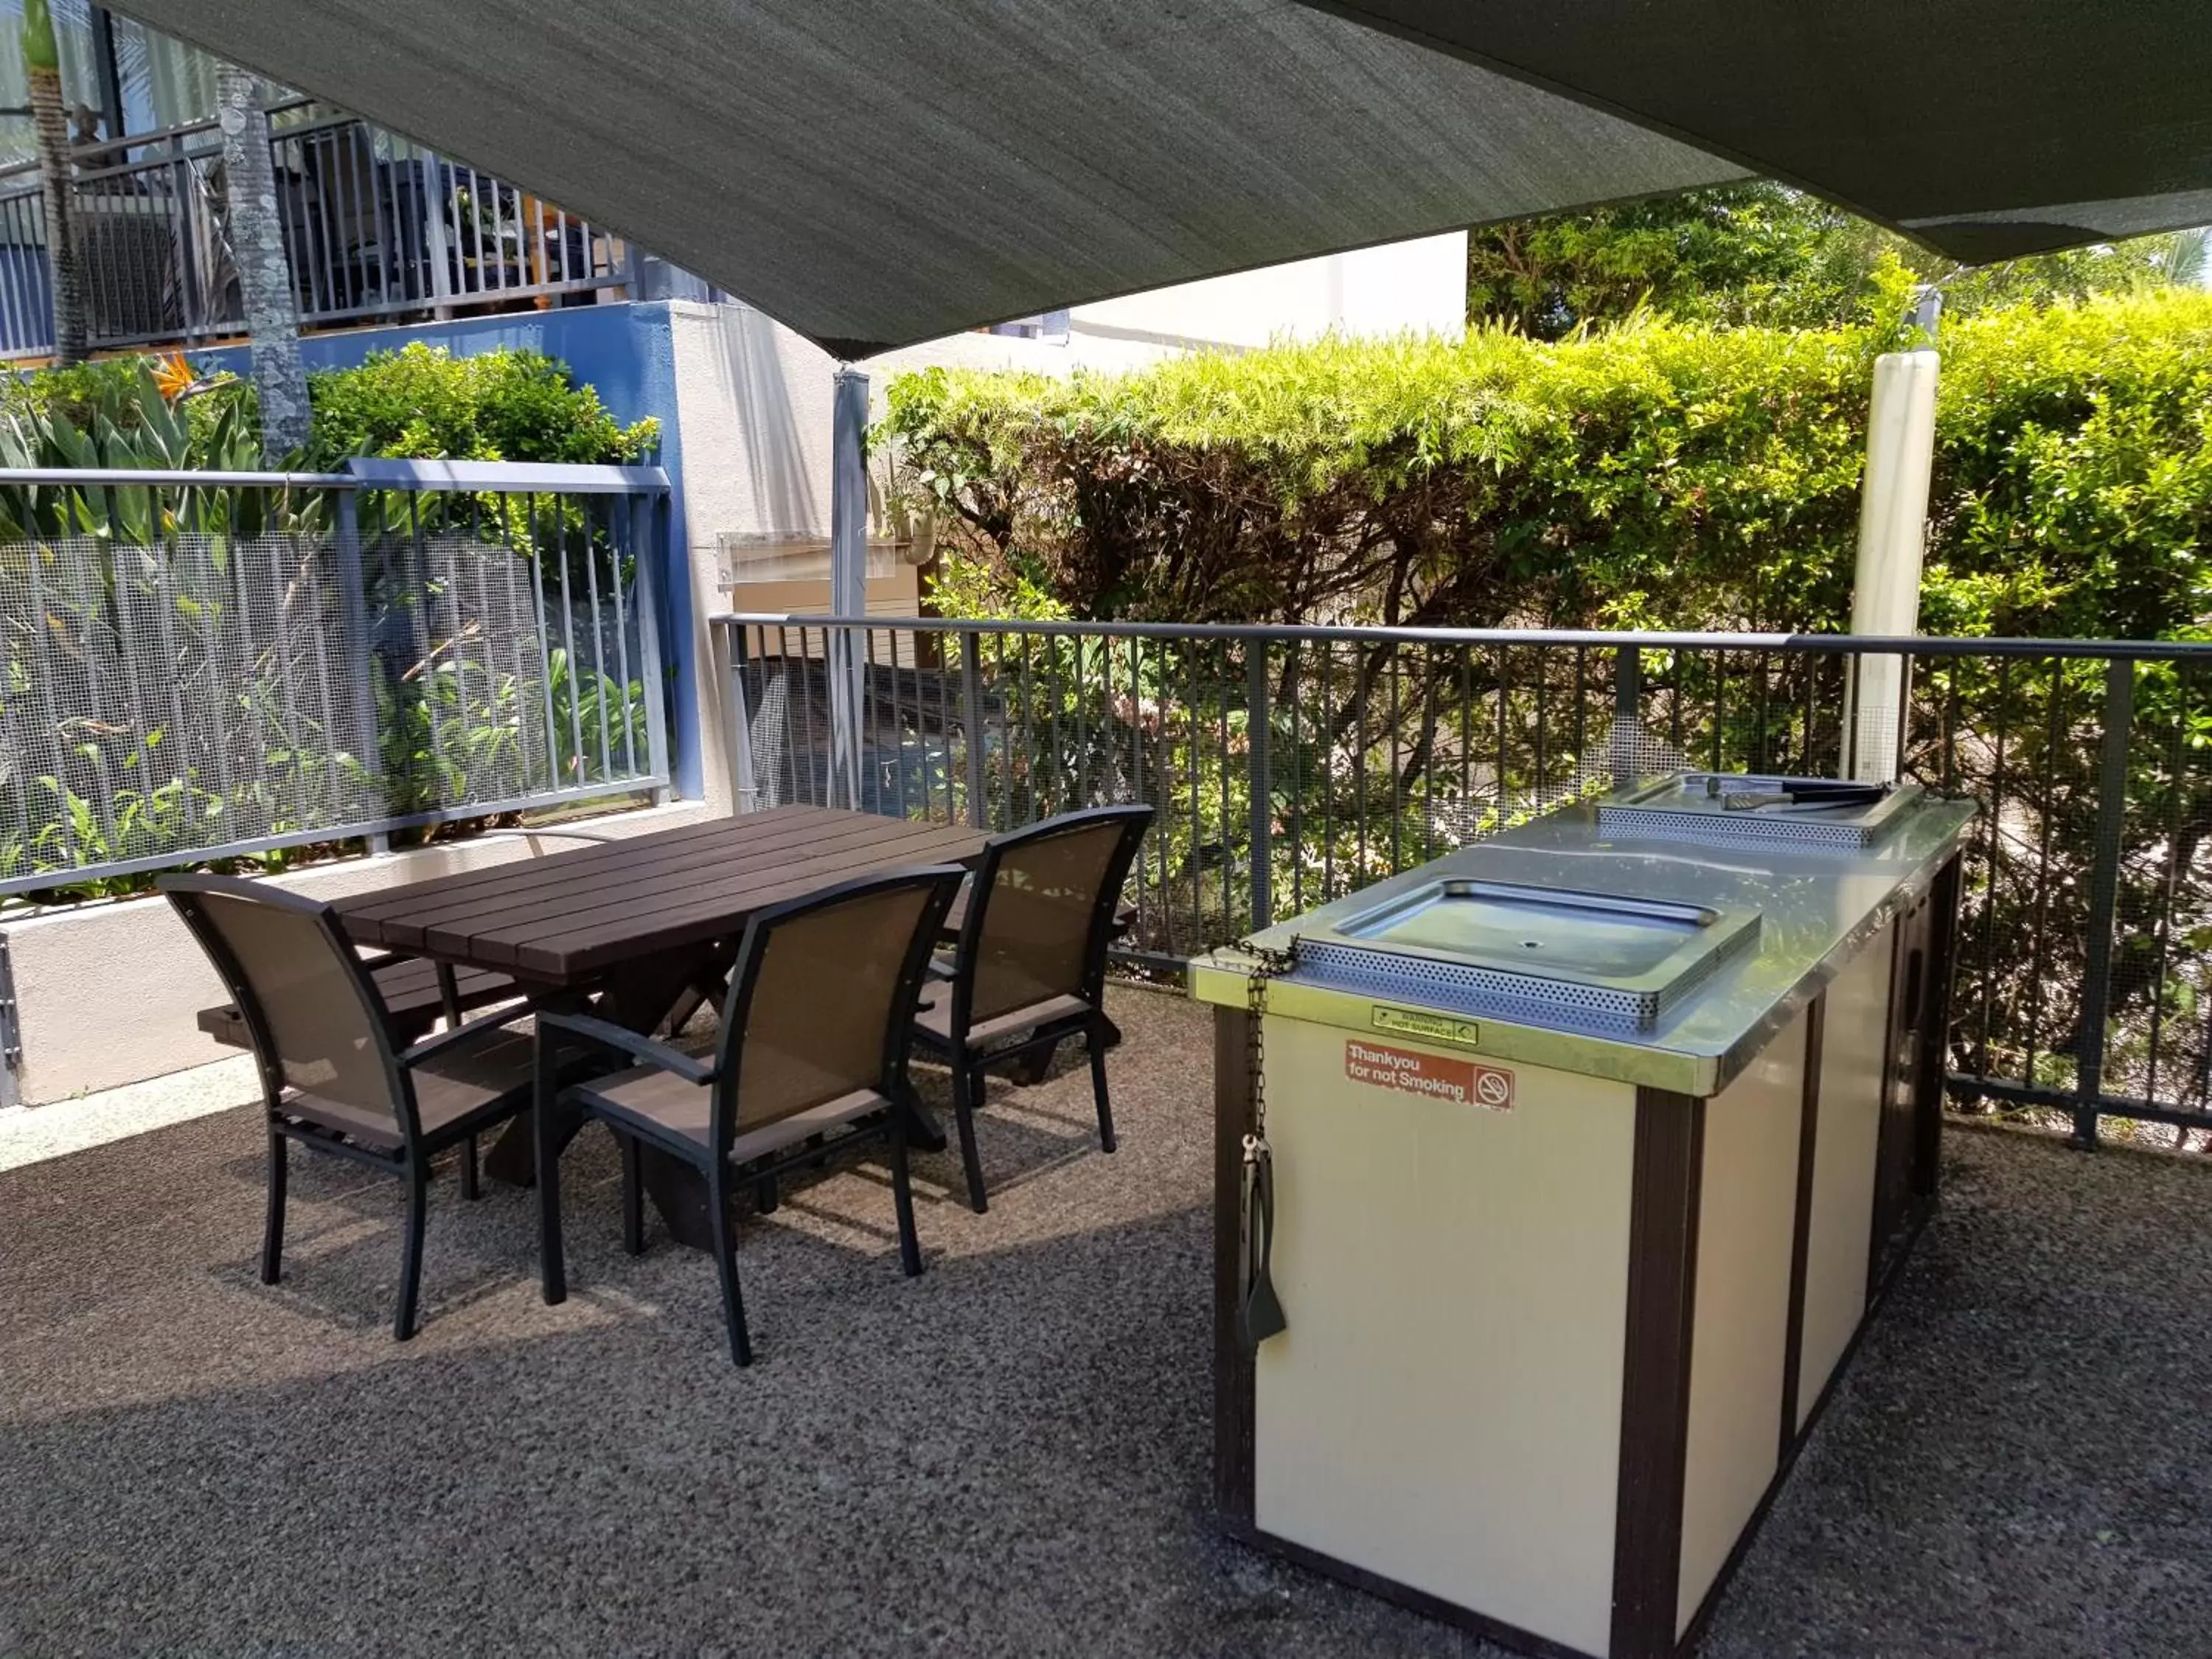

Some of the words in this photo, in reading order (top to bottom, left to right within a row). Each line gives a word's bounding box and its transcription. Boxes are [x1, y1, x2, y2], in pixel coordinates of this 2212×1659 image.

[1391, 1019, 1409, 1029] HOT
[1411, 1021, 1452, 1037] SURFACE
[1349, 1045, 1420, 1071] Thankyou
[1349, 1062, 1370, 1077] for
[1373, 1069, 1397, 1083] not
[1399, 1071, 1464, 1099] Smoking
